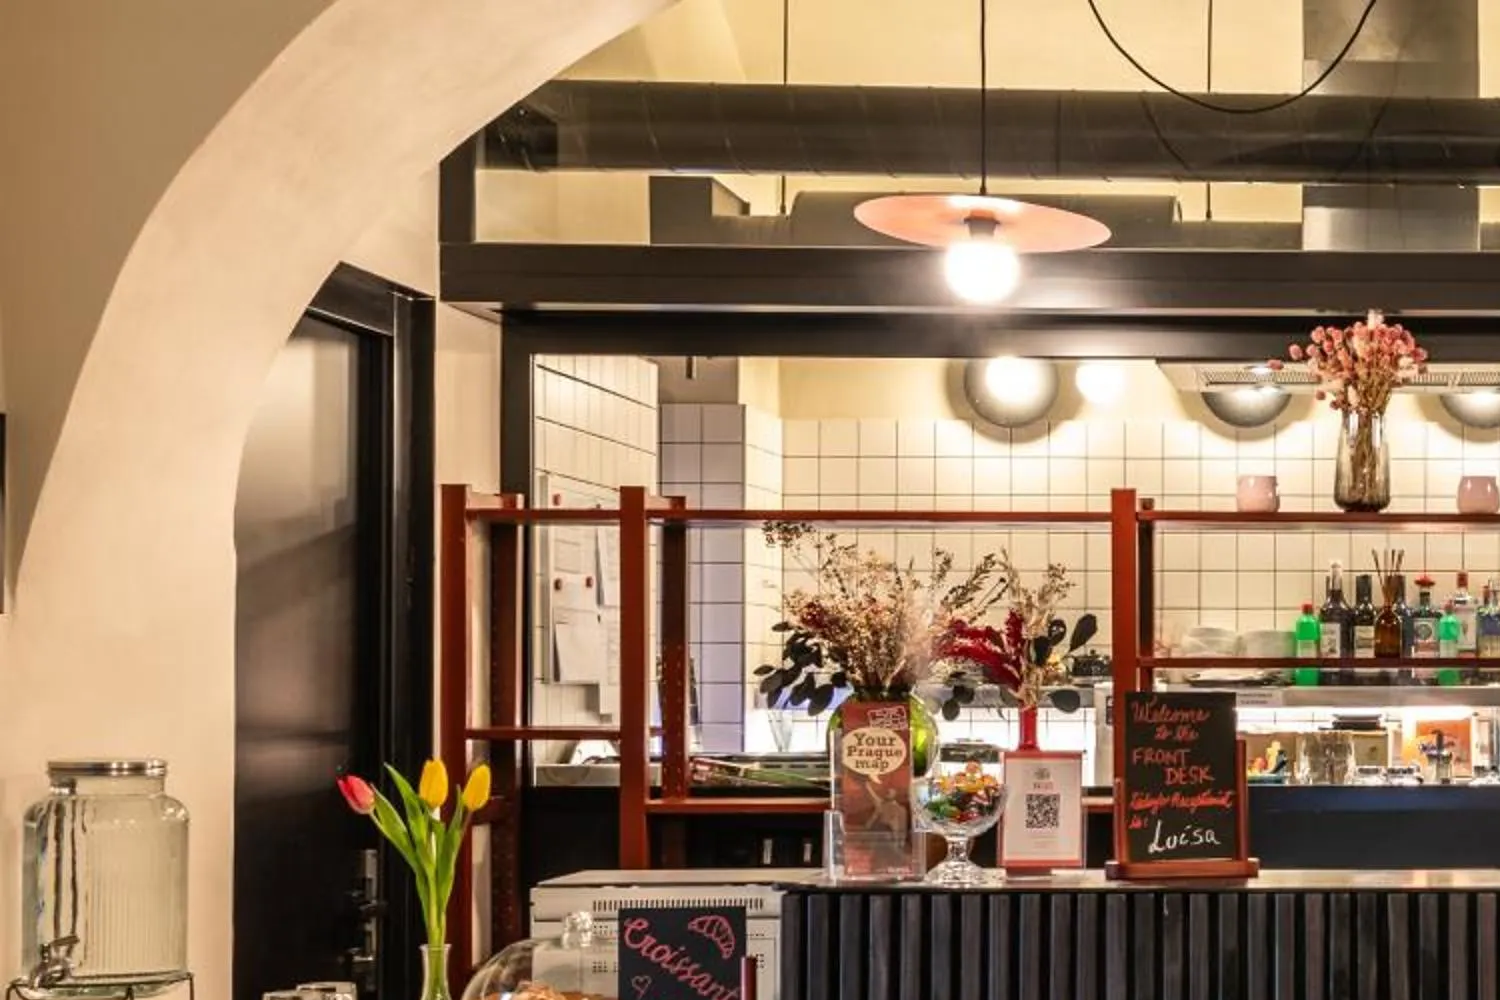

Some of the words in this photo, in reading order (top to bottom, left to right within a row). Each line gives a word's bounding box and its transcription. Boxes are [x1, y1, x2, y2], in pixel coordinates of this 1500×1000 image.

[1132, 696, 1210, 722] Welcome
[853, 732, 897, 747] Your
[847, 746, 903, 760] Prague
[1132, 747, 1191, 765] FRONT
[854, 759, 889, 771] map
[1164, 765, 1216, 785] DESK
